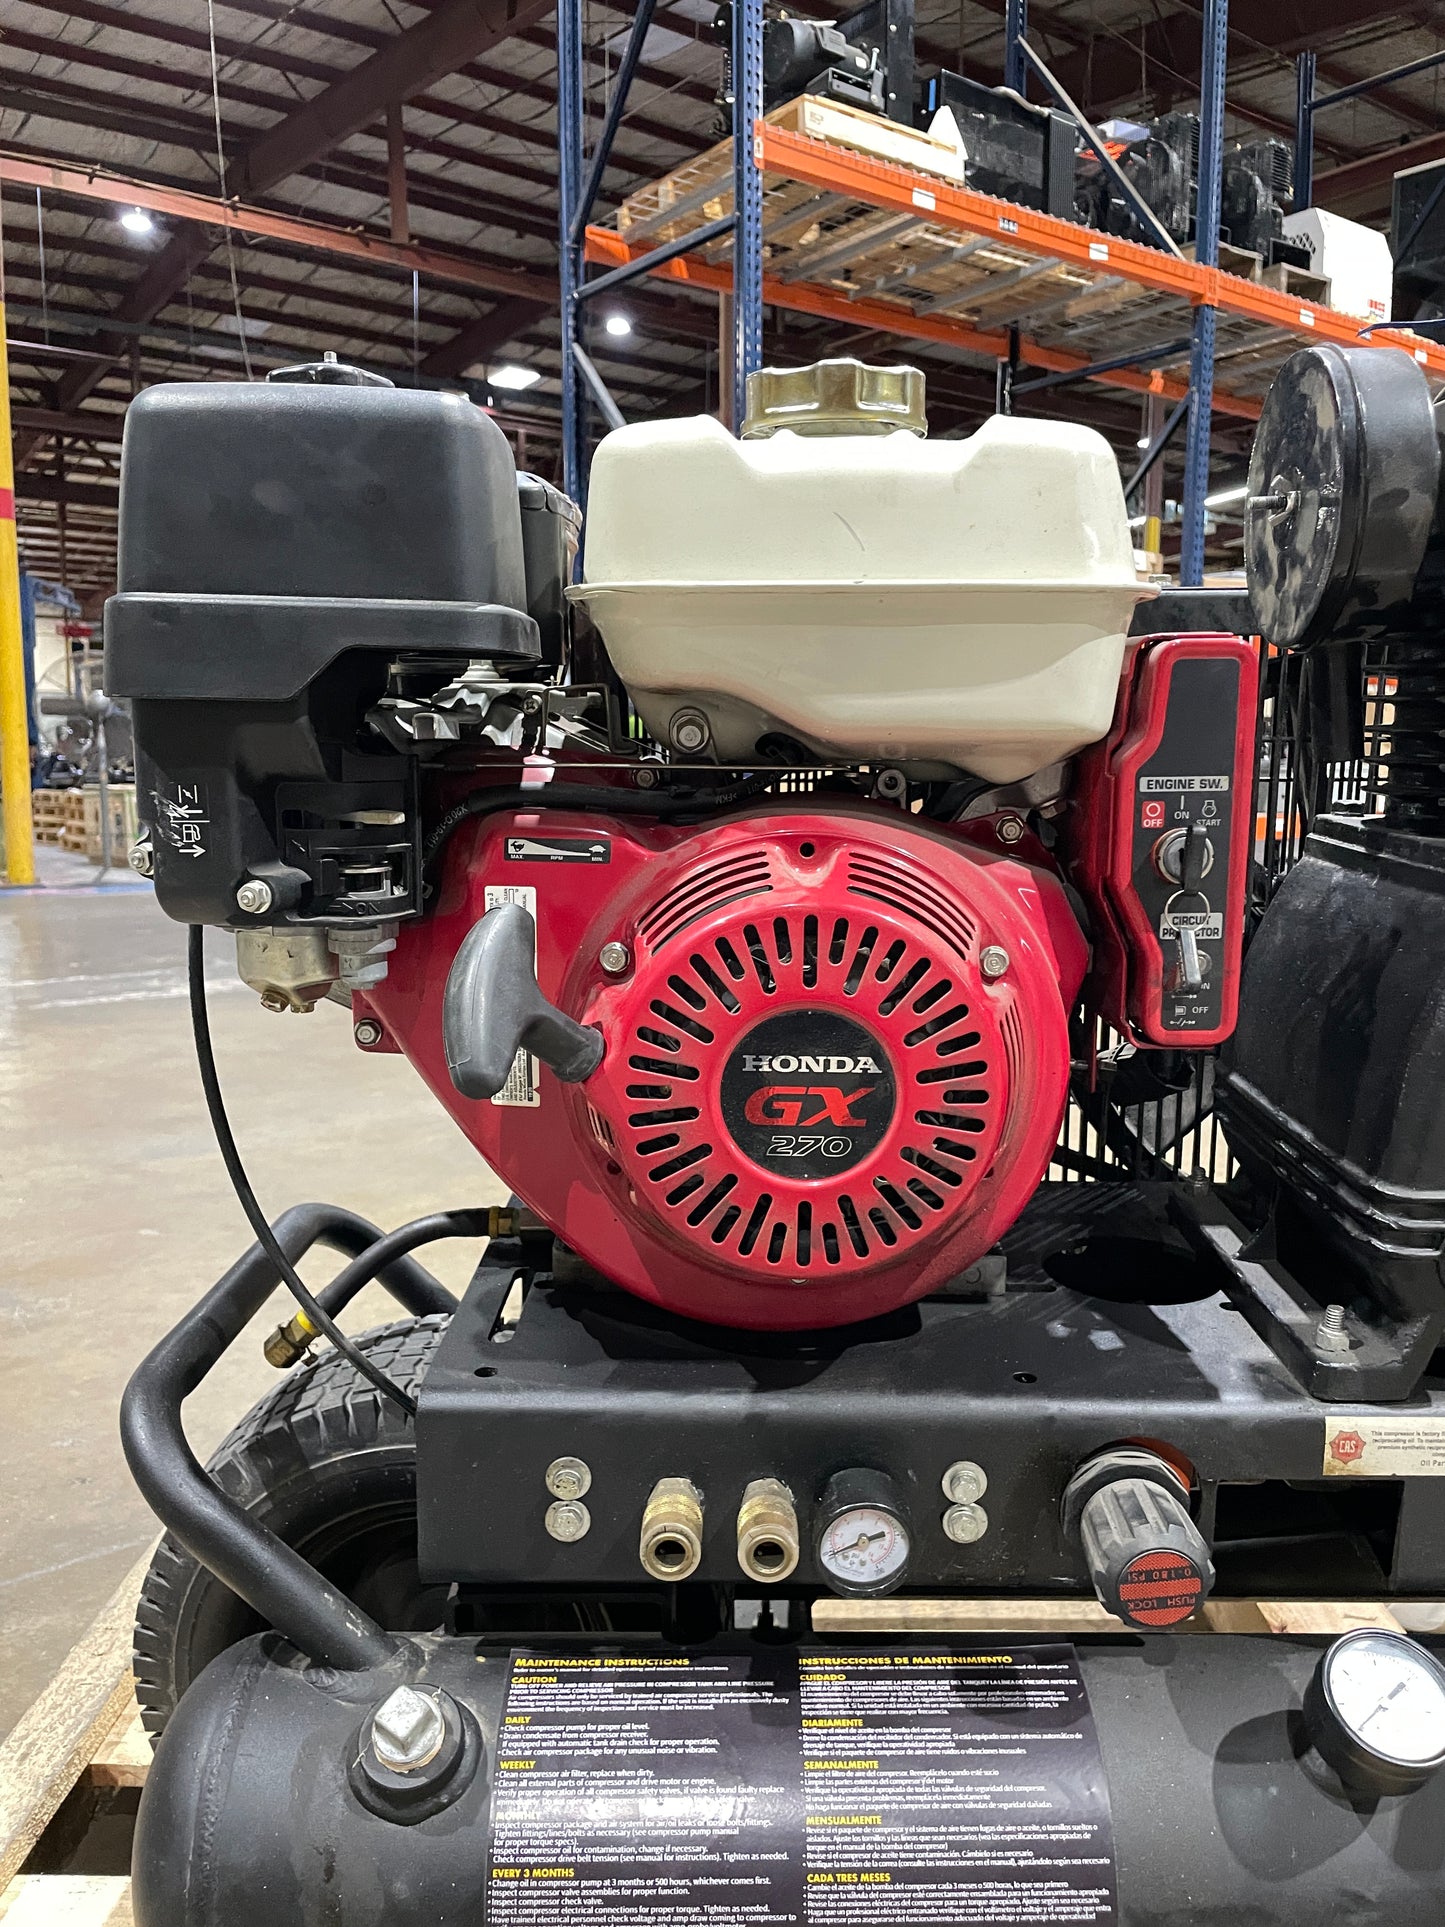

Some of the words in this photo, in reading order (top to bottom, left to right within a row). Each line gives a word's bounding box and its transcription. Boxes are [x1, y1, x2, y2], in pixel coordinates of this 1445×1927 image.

[1147, 779, 1194, 790] ENGINE
[1200, 779, 1223, 789] SW.
[1144, 819, 1162, 828] OFF
[1174, 811, 1190, 820] ON
[742, 1054, 882, 1073] HONDA
[744, 1086, 876, 1127] GX
[766, 1135, 852, 1158] 270
[1128, 1572, 1146, 1581] PSI
[1152, 1568, 1192, 1580] 0-180
[1128, 1600, 1157, 1610] LOCK
[1167, 1596, 1196, 1606] PUSH
[515, 1658, 600, 1666] MAINTENANCE
[912, 1656, 1012, 1664] MANTENIMIENTO
[505, 1716, 531, 1724] DAILY
[802, 1719, 863, 1727] DIARIAMENTE
[500, 1760, 536, 1769] WEEKLY
[804, 1760, 879, 1769] SEMANALMENTE
[557, 1778, 574, 1787] parts
[690, 1777, 716, 1786] engine.
[806, 1816, 882, 1824] MENSUALMENTE
[492, 1869, 521, 1878] EVERY
[524, 1868, 530, 1878] 3
[532, 1868, 574, 1878] MONTHS
[807, 1874, 834, 1882] CADA
[836, 1874, 858, 1882] TRES
[860, 1873, 891, 1882] MESES
[492, 1879, 518, 1888] Change
[492, 1888, 517, 1897] Inspect
[492, 1897, 517, 1906] Inspect
[491, 1906, 517, 1915] Inspect
[675, 1905, 702, 1914] torque.
[703, 1905, 730, 1914] Tighten
